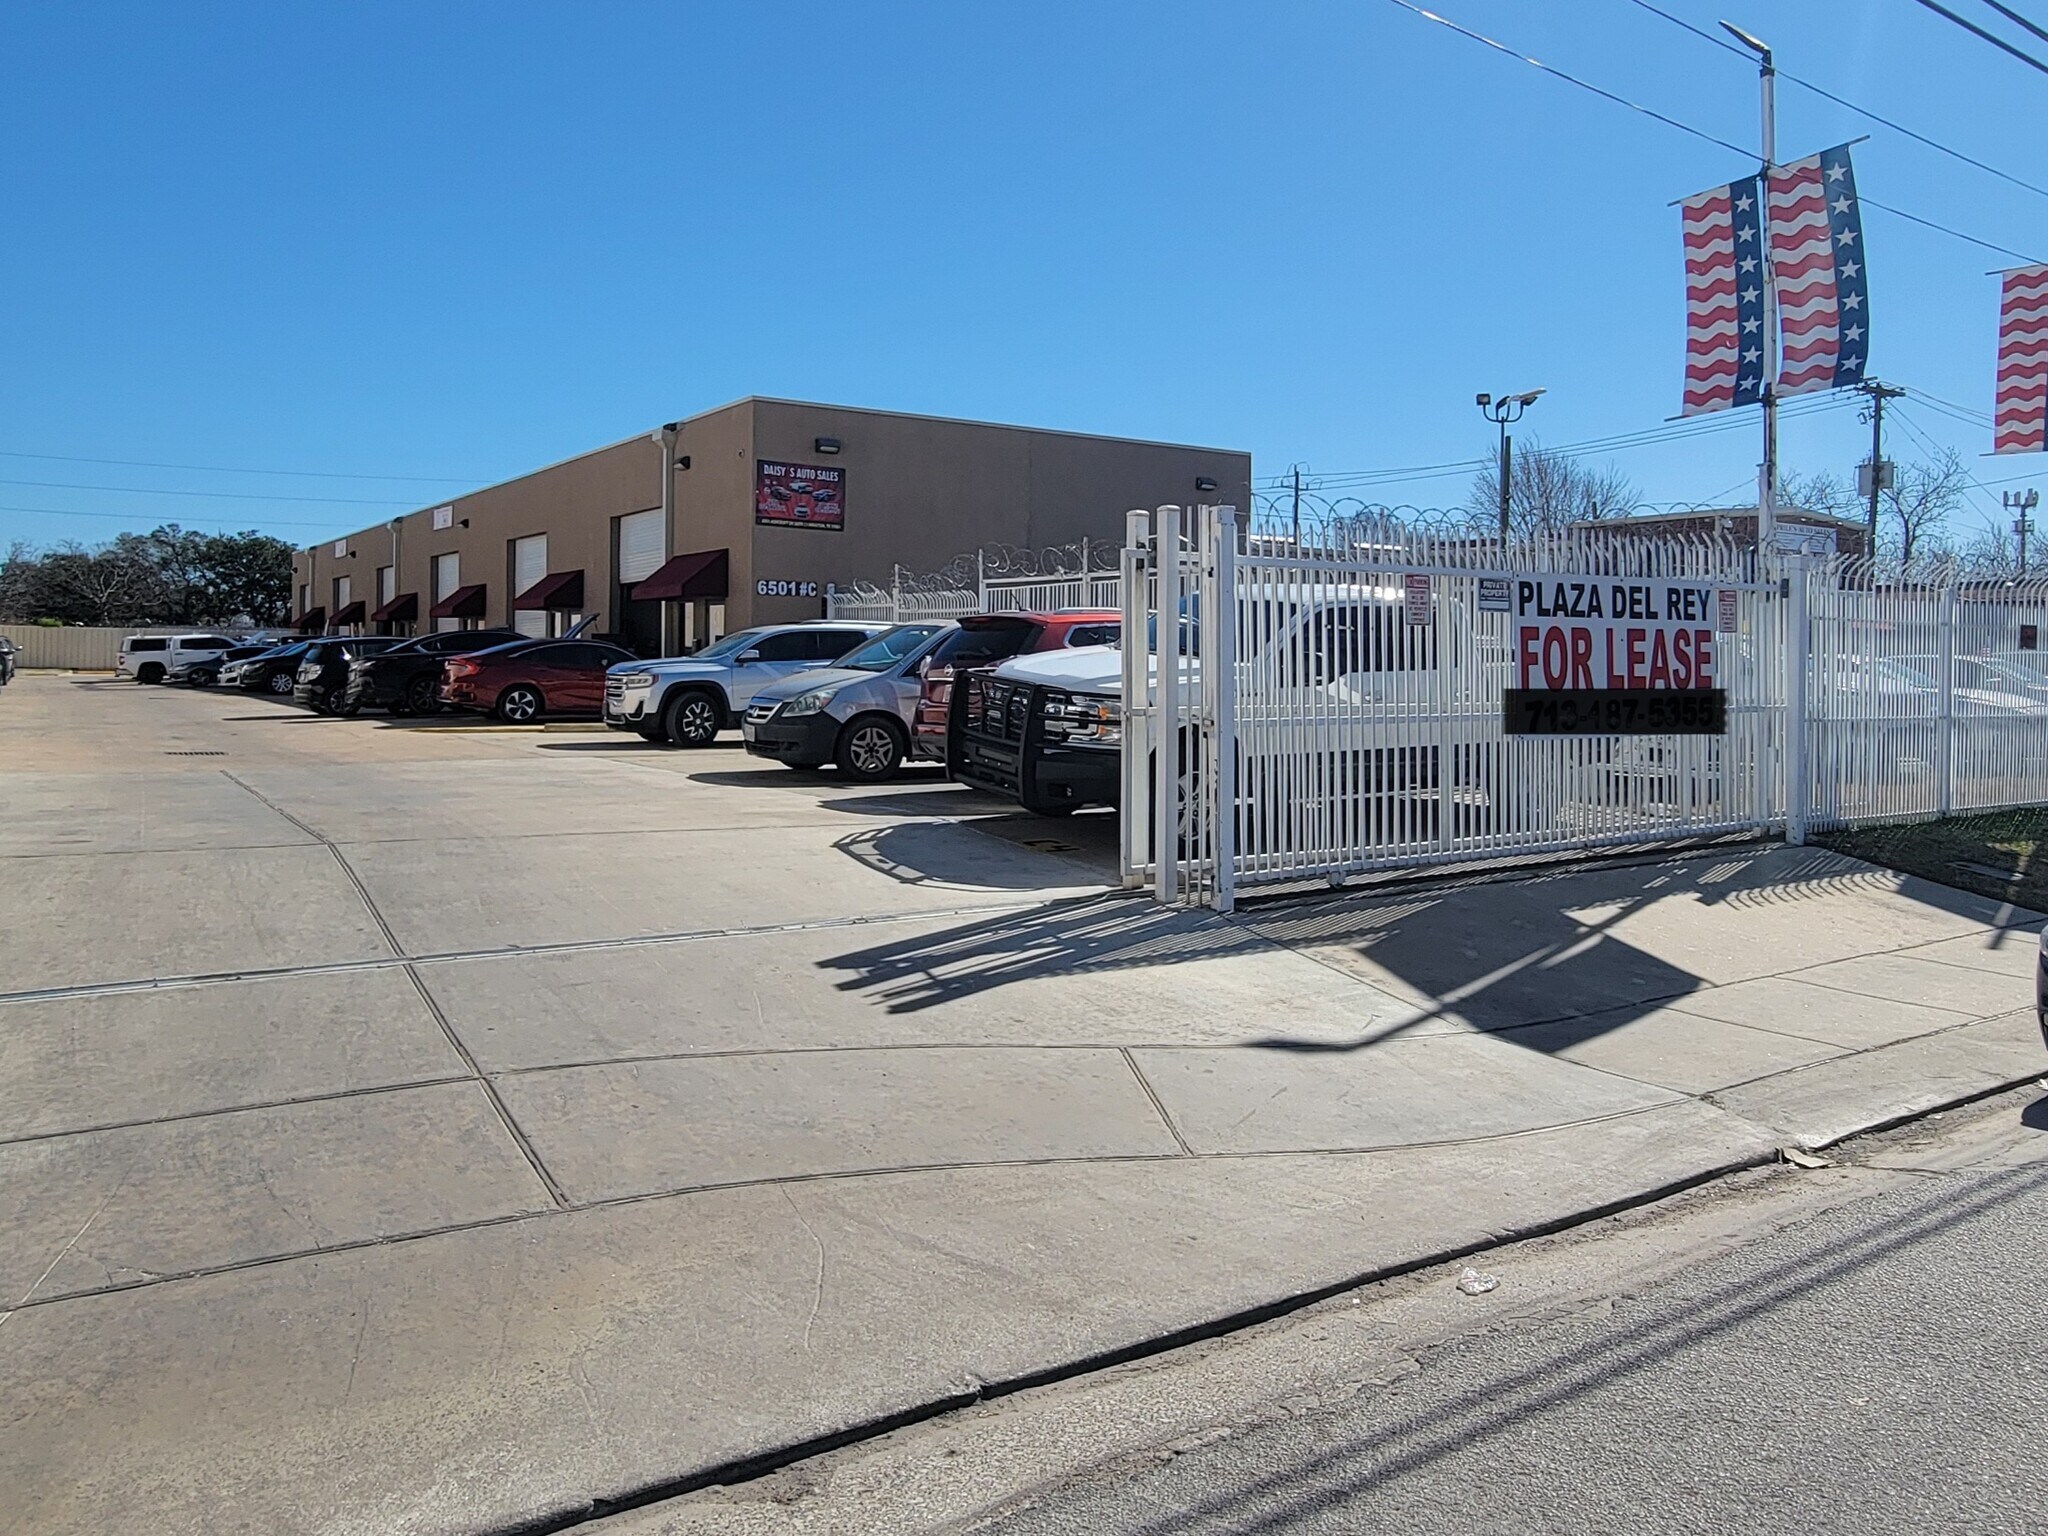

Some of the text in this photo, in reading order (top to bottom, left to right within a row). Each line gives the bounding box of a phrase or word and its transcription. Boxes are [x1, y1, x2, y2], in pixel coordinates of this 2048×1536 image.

[763, 464, 786, 477] DAISY
[796, 468, 816, 480] AUTO
[817, 470, 839, 482] SALES
[1480, 589, 1509, 597] PROPERTY
[1483, 581, 1508, 589] PRIVATE
[1518, 580, 1603, 619] PLAZA
[1611, 585, 1658, 620] DEL
[1667, 587, 1711, 621] REY
[1520, 626, 1712, 692] FOR LEASE
